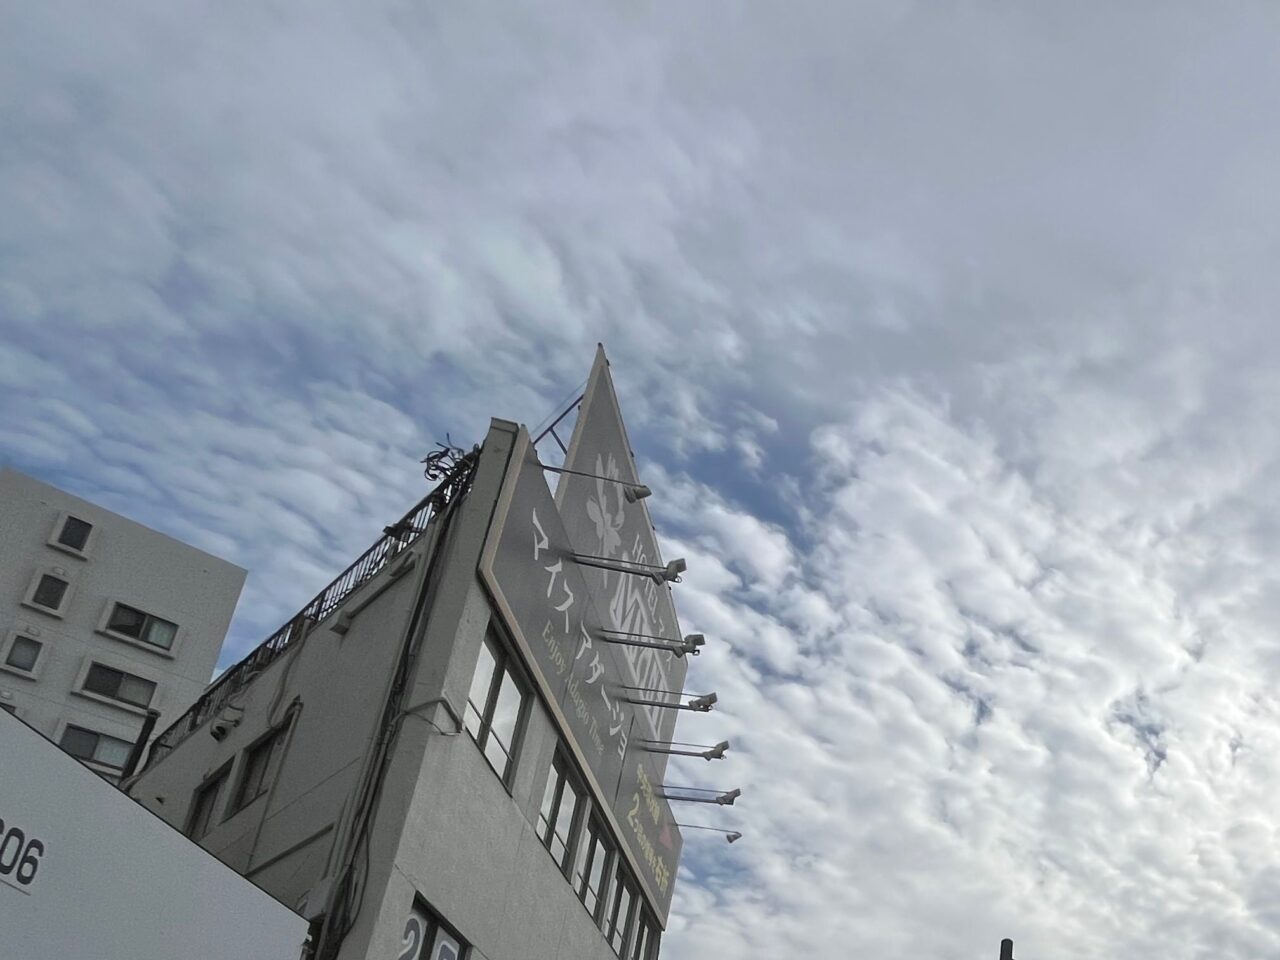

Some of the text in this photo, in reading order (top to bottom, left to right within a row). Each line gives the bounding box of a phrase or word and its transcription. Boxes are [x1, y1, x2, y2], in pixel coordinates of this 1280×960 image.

[632, 533, 657, 623] HOTEL
[533, 508, 627, 760] マイス アダージョ
[542, 620, 567, 674] Enjoy
[0, 818, 44, 885] 06
